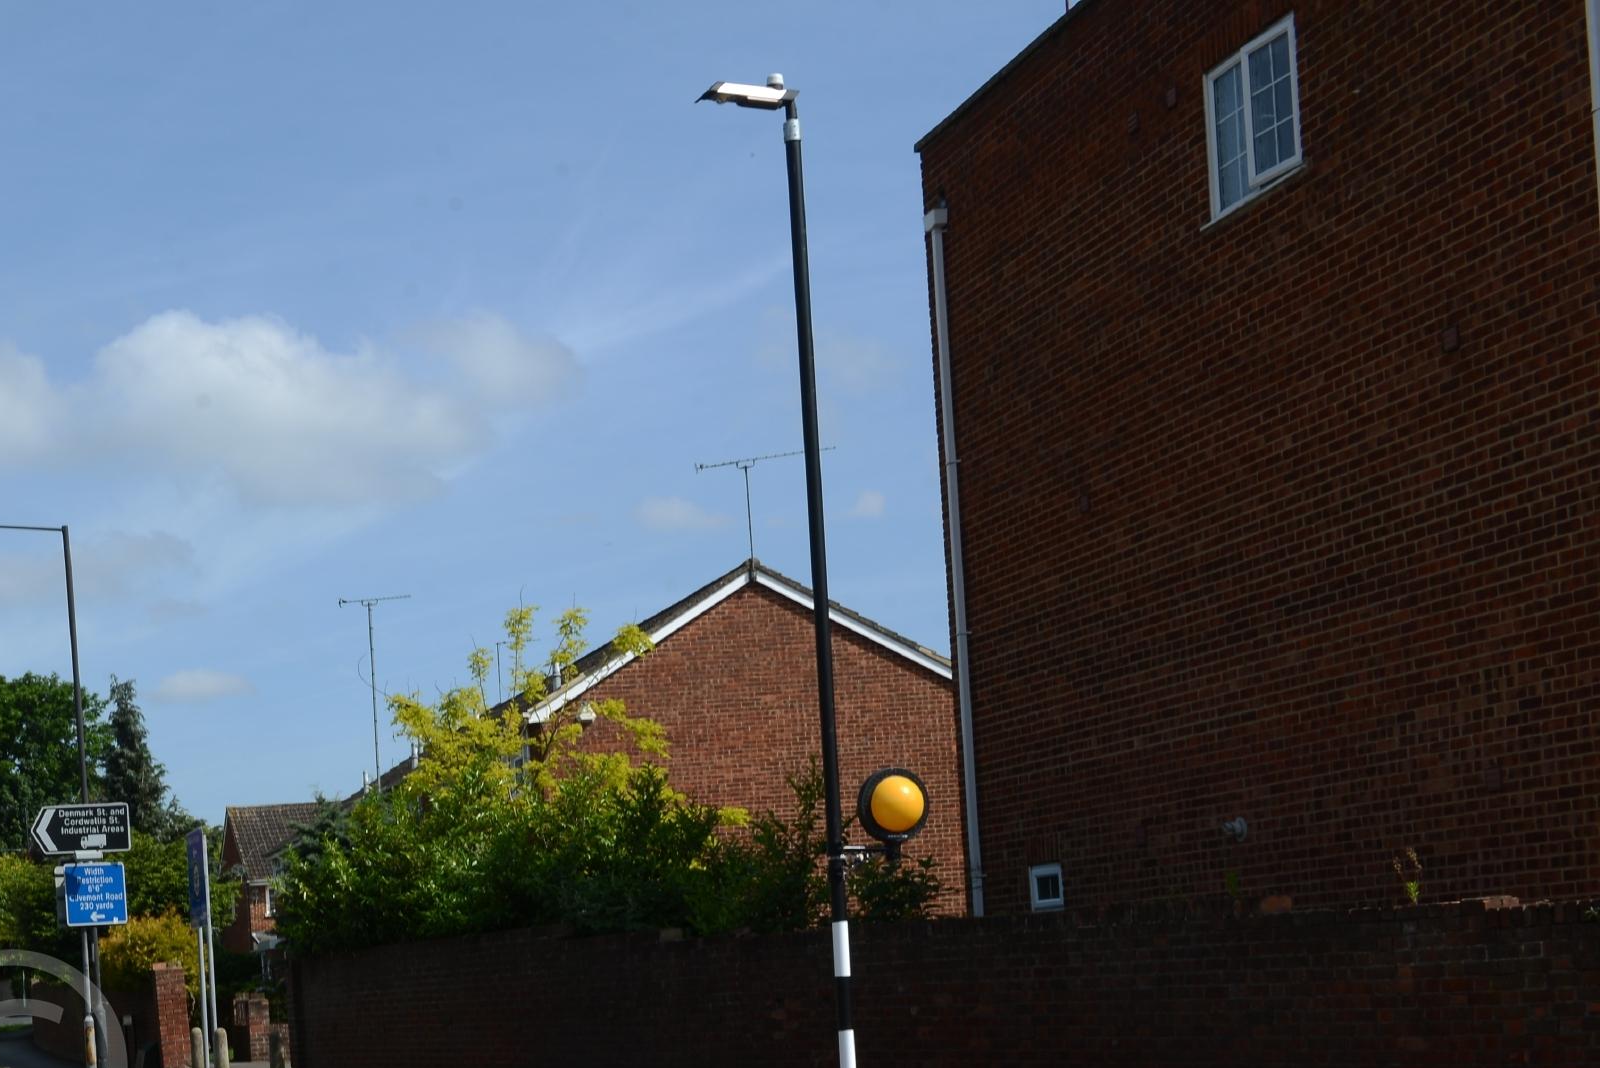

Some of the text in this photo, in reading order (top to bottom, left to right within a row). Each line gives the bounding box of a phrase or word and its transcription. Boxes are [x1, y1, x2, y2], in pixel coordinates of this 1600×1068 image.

[58, 808, 94, 818] Denmark
[110, 808, 125, 816] and
[64, 817, 106, 826] Cordwallis
[60, 824, 124, 834] Industrial Areas
[84, 867, 104, 876] Width
[106, 892, 123, 900] Road
[96, 902, 114, 910] yards
